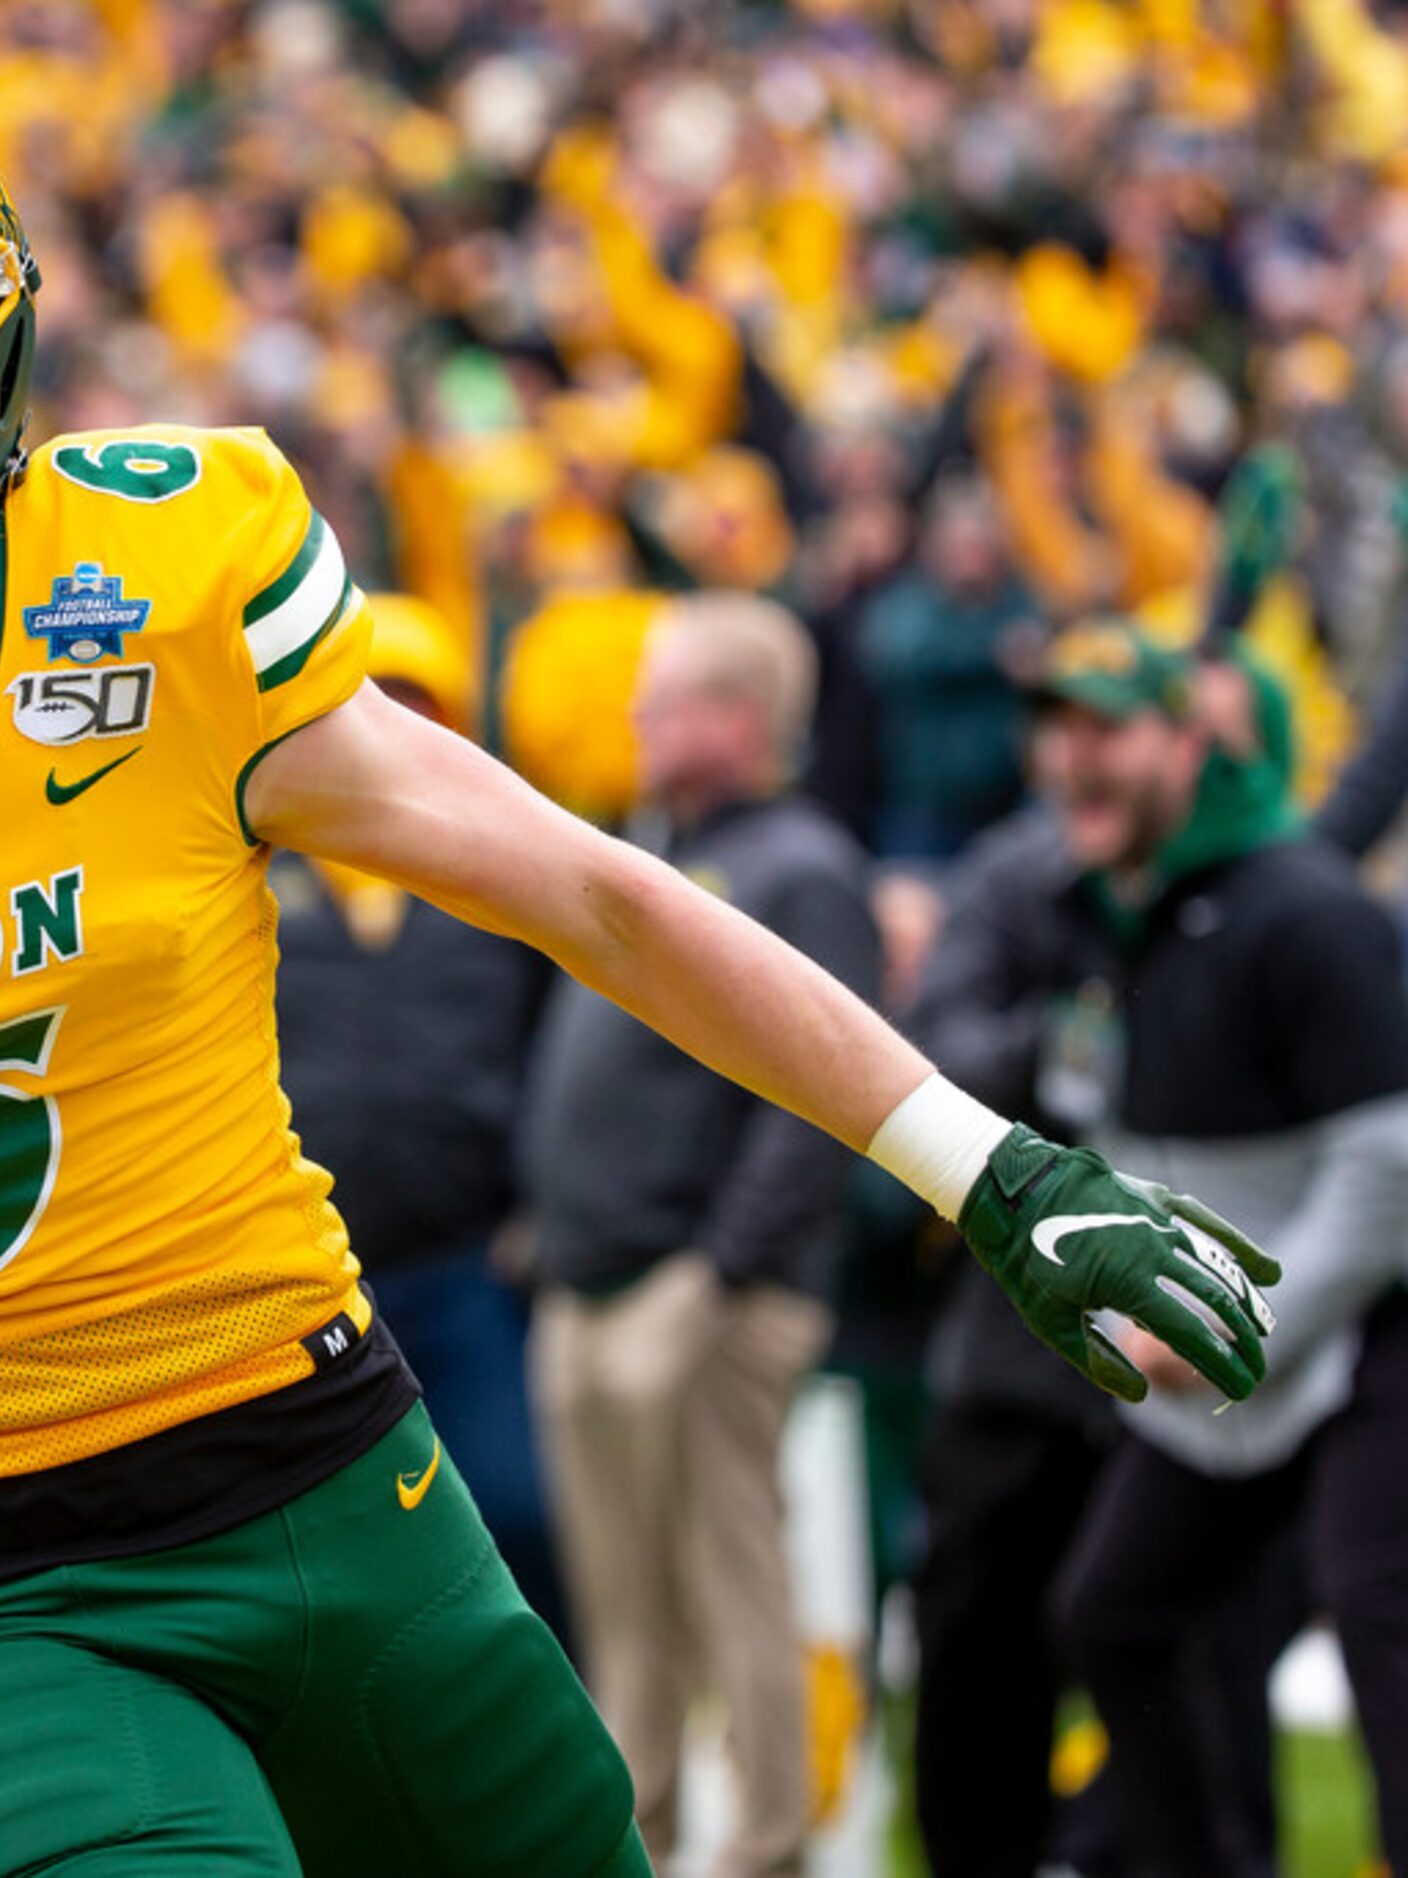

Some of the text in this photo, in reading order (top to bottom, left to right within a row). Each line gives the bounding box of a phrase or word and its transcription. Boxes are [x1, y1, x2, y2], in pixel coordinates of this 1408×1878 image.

[51, 439, 202, 504] 6
[33, 608, 141, 629] CHAMPIONSHIP
[58, 598, 111, 611] FOOTBALL
[18, 666, 152, 742] 150
[322, 1325, 349, 1357] M
